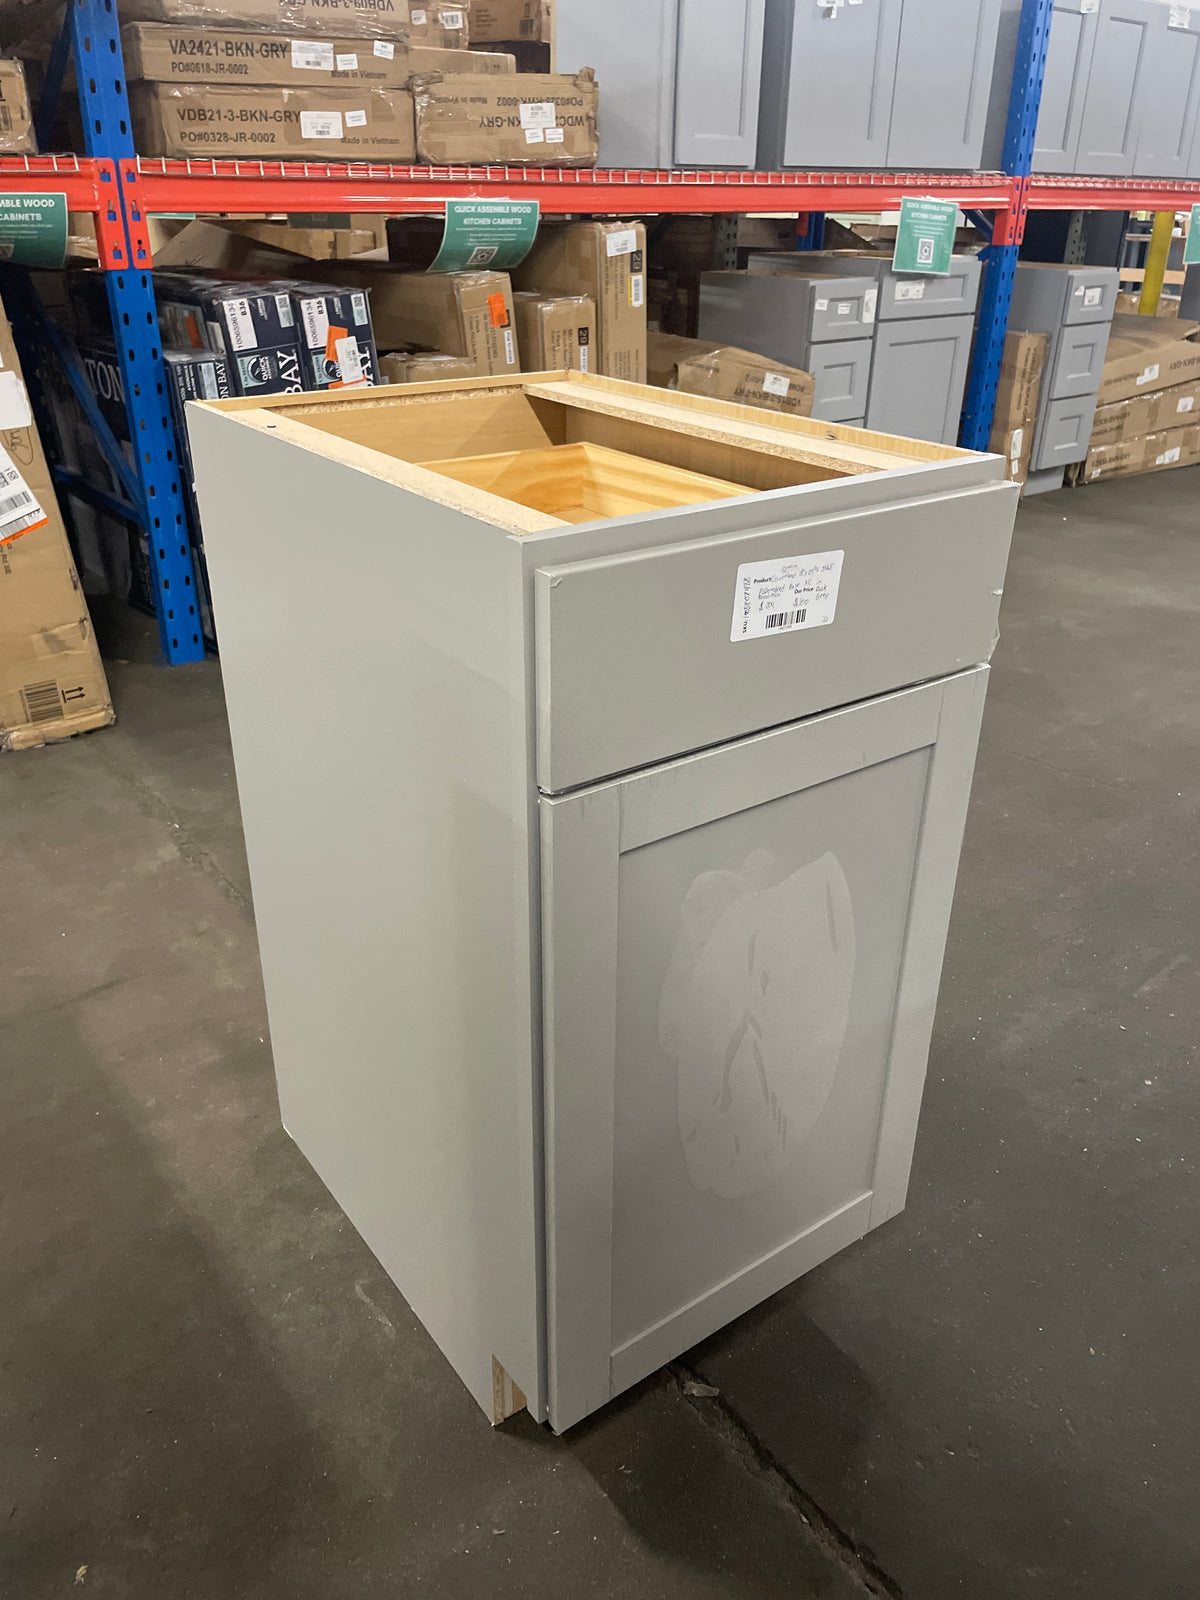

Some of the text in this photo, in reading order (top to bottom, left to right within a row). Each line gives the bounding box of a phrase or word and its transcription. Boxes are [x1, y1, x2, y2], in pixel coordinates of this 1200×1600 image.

[168, 39, 288, 58] VA2421-BKN-GRY
[177, 108, 301, 122] VDB21-3-BKN-GRY
[180, 132, 276, 143] PO#0328-JR-0002
[23, 198, 55, 207] WOOD
[214, 361, 227, 384] BAY
[259, 356, 268, 380] QUICK
